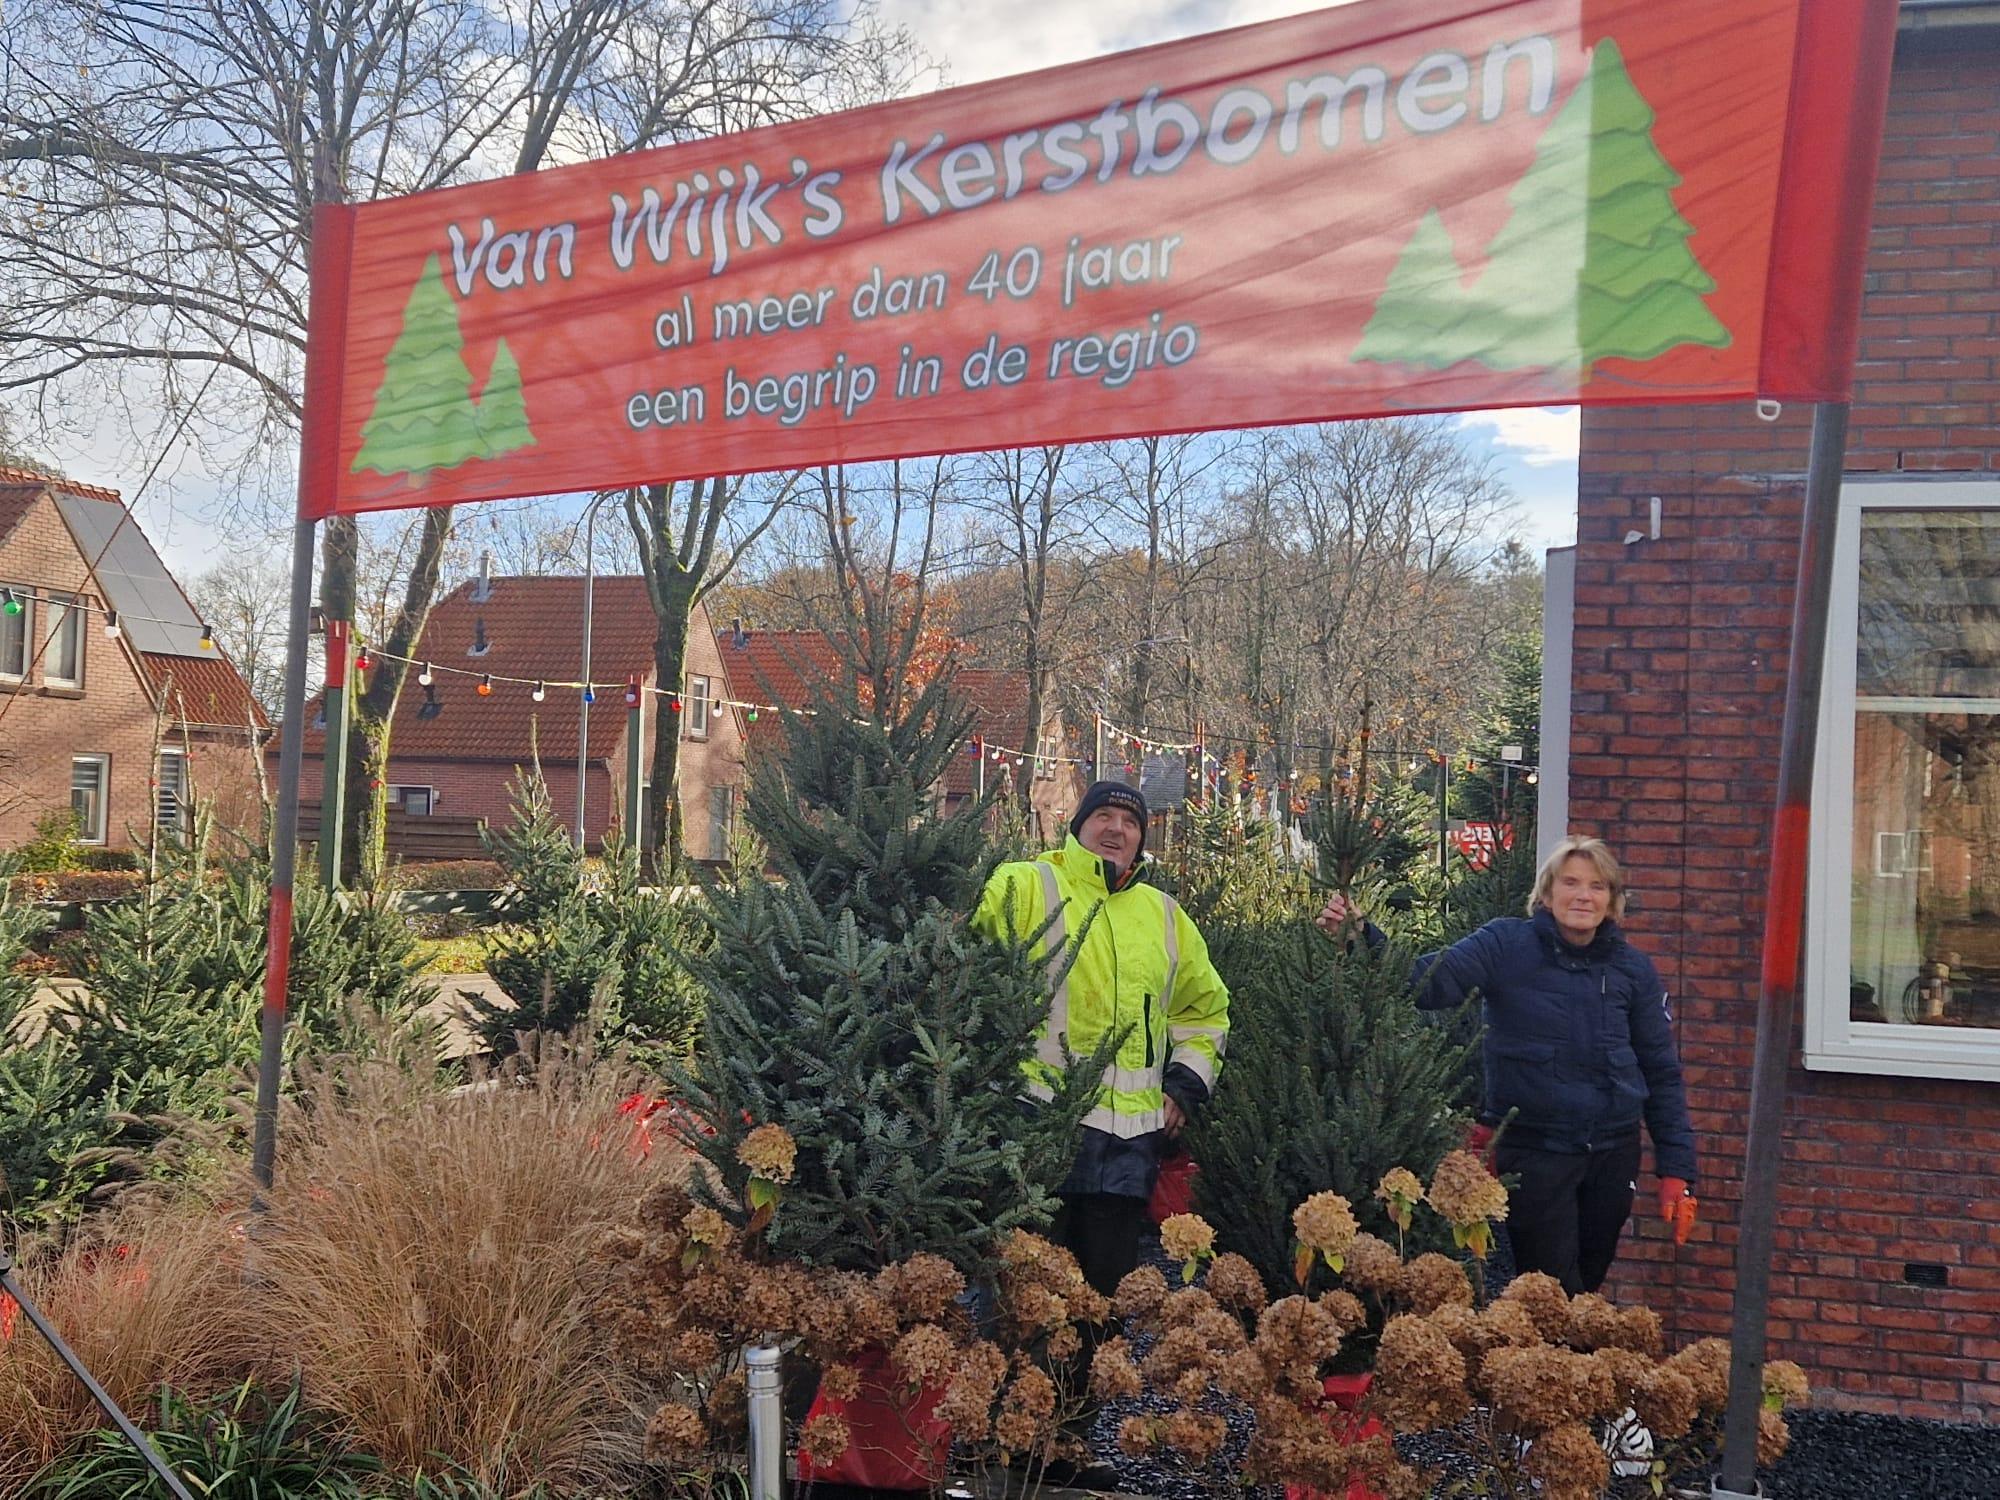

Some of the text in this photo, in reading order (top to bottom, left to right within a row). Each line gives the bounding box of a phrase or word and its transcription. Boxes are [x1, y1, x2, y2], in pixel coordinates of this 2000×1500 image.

[447, 34, 1556, 297] Van Wijk's Kerstbomen
[655, 237, 1182, 348] al meer dan 40 jaar
[626, 312, 1198, 429] een begrip in de regio
